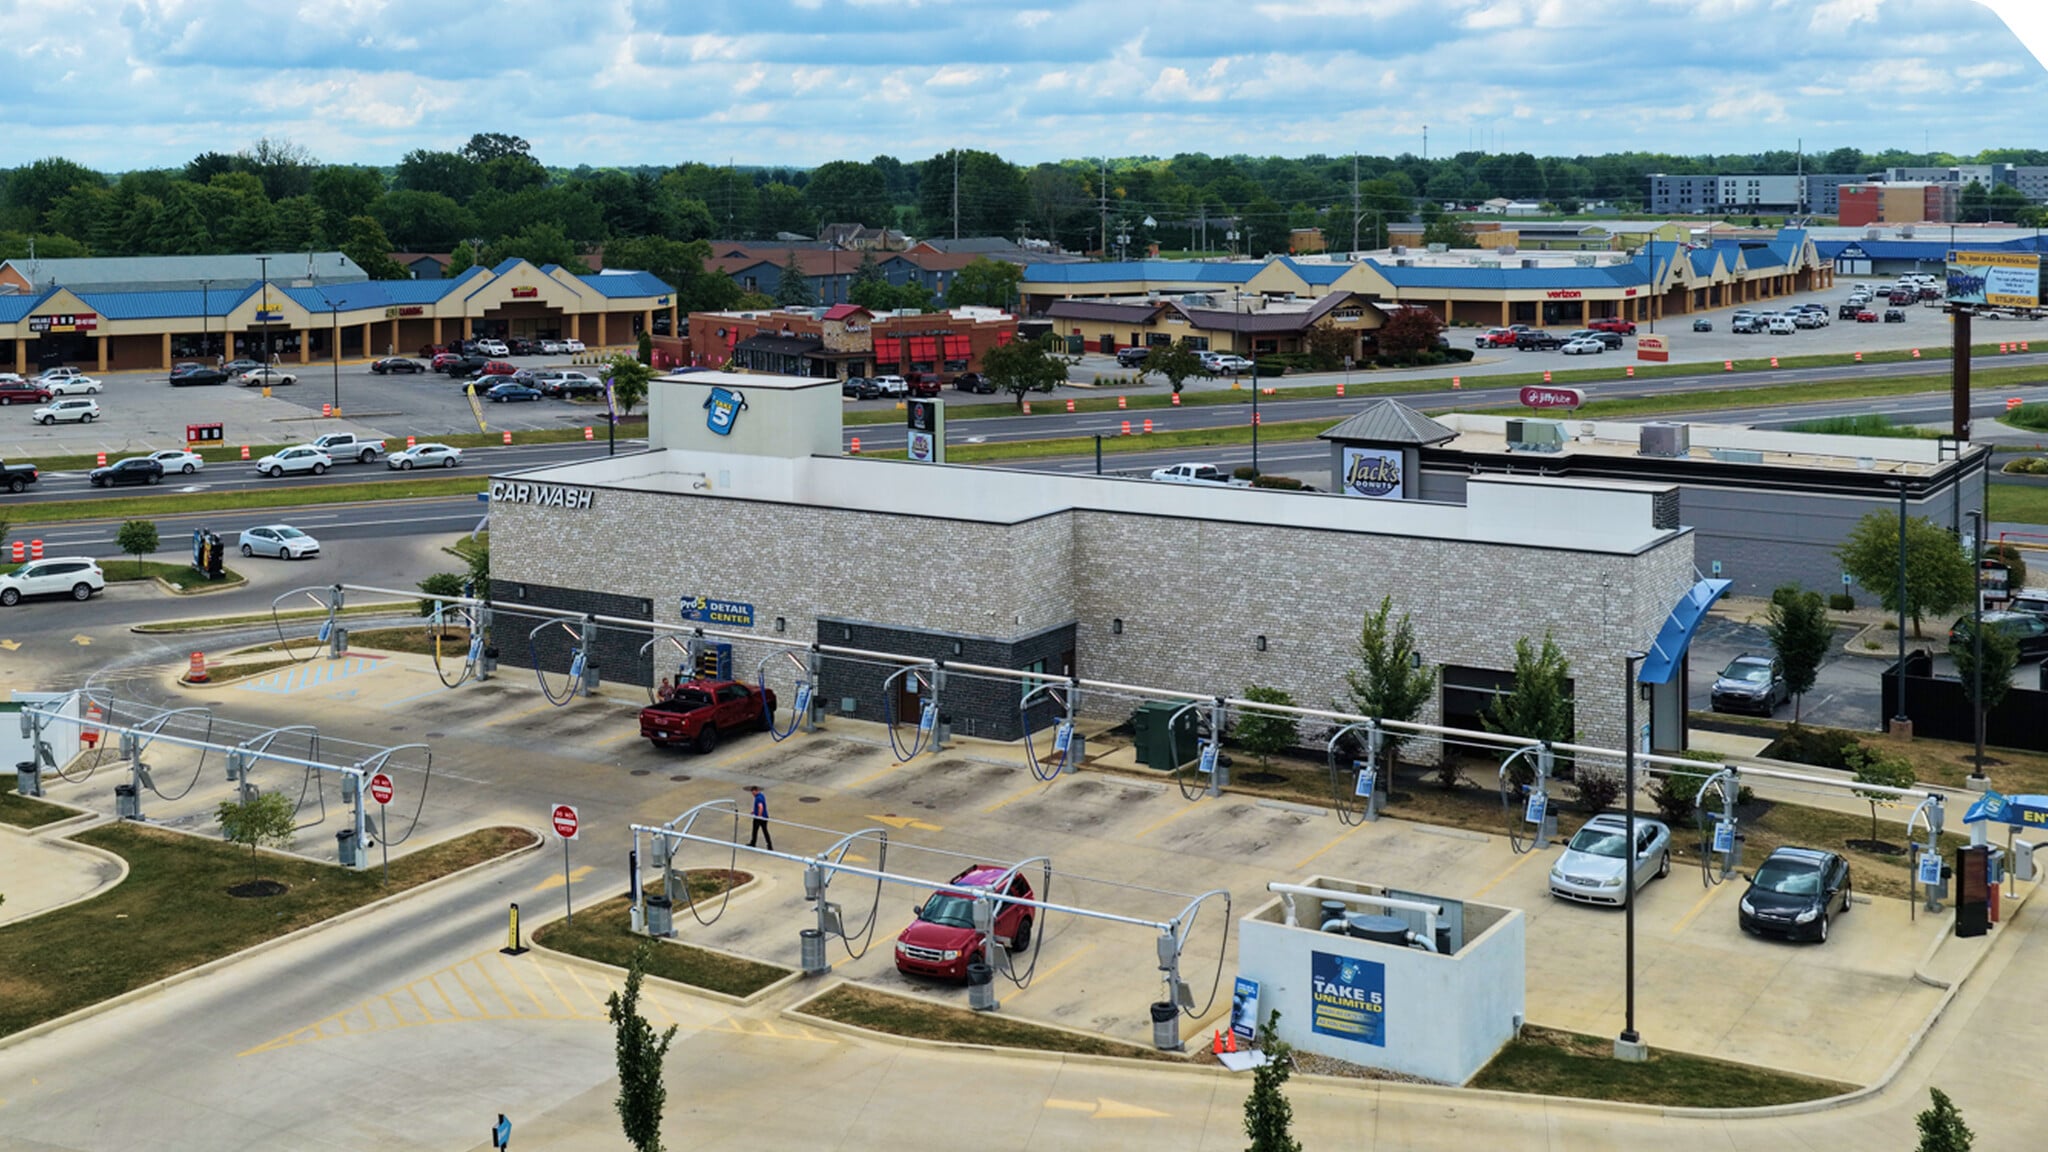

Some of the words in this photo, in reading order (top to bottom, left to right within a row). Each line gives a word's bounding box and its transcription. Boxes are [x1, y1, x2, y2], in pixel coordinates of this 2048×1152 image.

[1547, 289, 1581, 298] verizon
[1331, 309, 1364, 317] OUTBACK
[712, 406, 731, 426] 5
[1344, 453, 1400, 488] Jack's
[1356, 480, 1392, 489] DONUTS
[492, 482, 531, 503] CAR
[535, 485, 594, 509] WASH
[710, 603, 748, 614] DETAIL
[710, 612, 750, 624] CENTER
[2024, 810, 2048, 823] EN
[1314, 980, 1365, 1001] TAKE
[1370, 992, 1382, 1004] 5
[1314, 992, 1382, 1013] UNLIMITED
